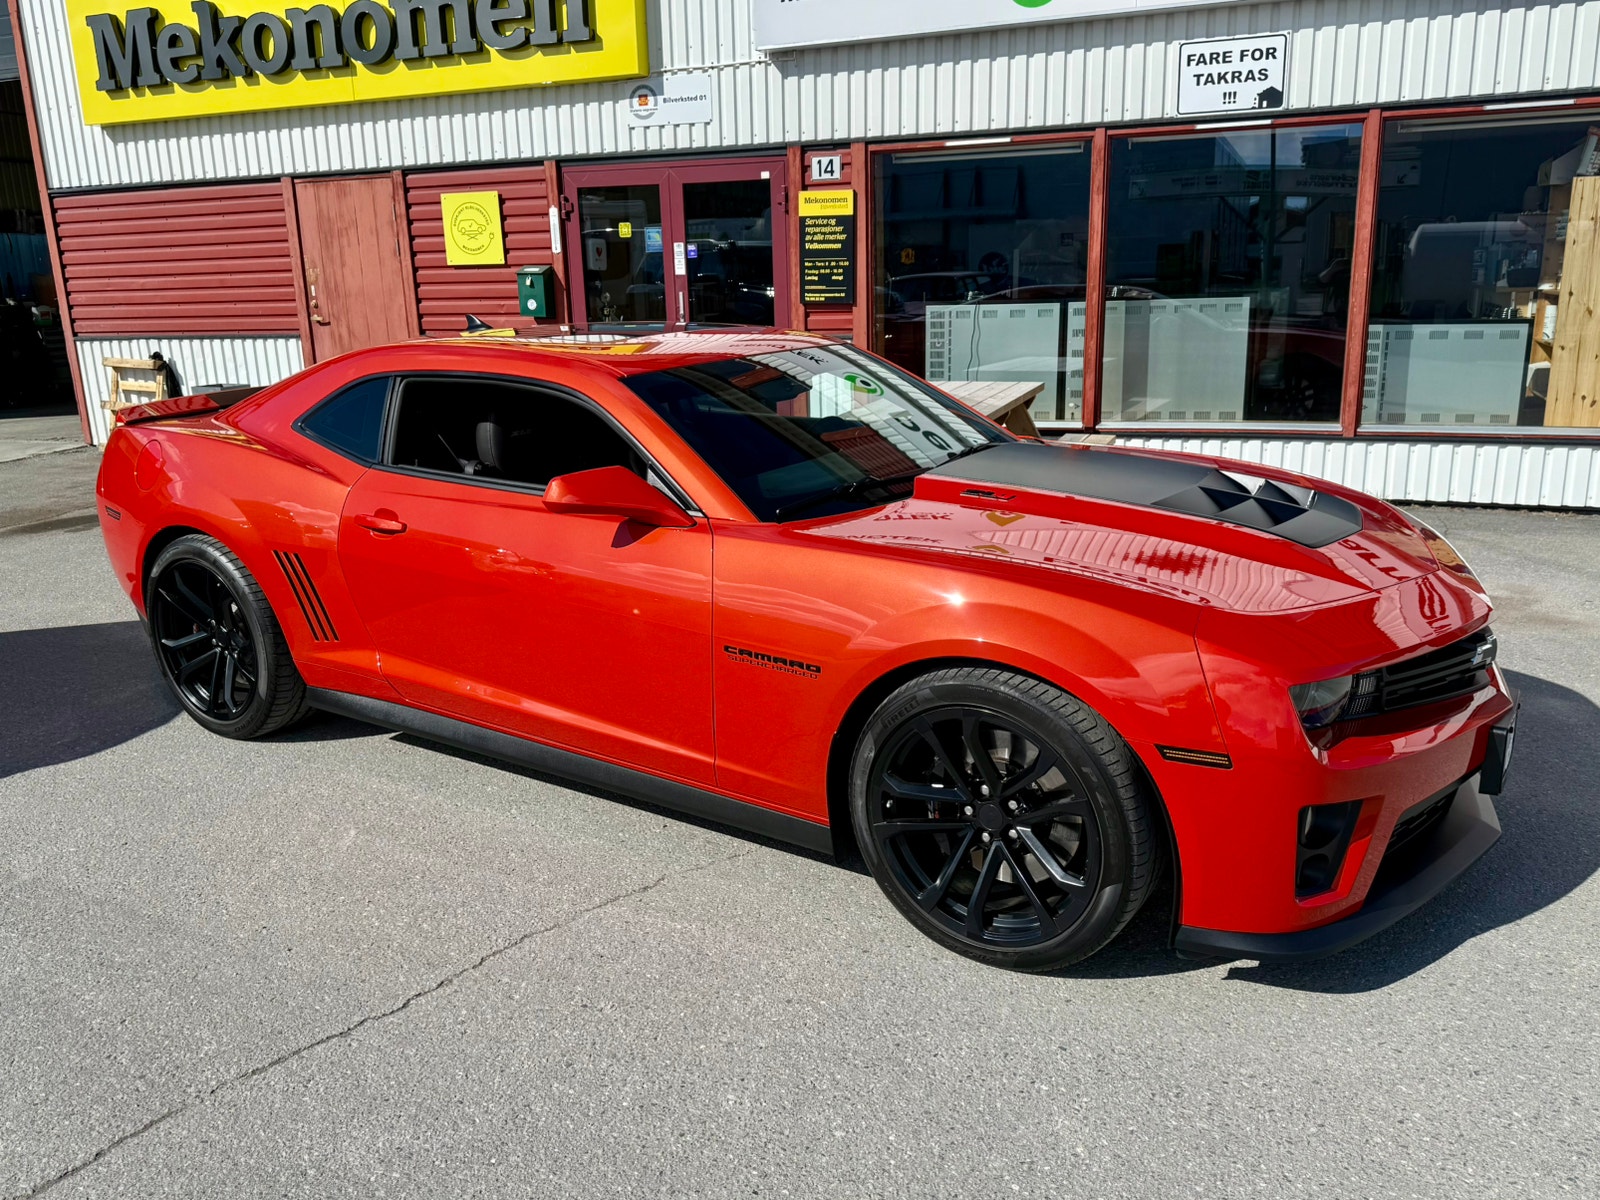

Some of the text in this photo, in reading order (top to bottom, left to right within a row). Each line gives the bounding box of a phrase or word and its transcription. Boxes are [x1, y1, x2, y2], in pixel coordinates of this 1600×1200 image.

[86, 0, 597, 92] Mekonomen
[1186, 47, 1277, 67] FARE FOR
[1193, 68, 1269, 86] TAKRAS
[663, 95, 698, 104] Bilverksted
[817, 158, 835, 177] 14
[804, 196, 848, 204] Mekonomen
[805, 218, 836, 226] Service og
[805, 226, 844, 234] reparasjoner
[813, 233, 825, 241] alle
[825, 233, 847, 241] merker
[805, 242, 842, 250] Velkommen
[723, 645, 822, 674] CAMARO
[727, 655, 819, 680] SUPERCHARGED
